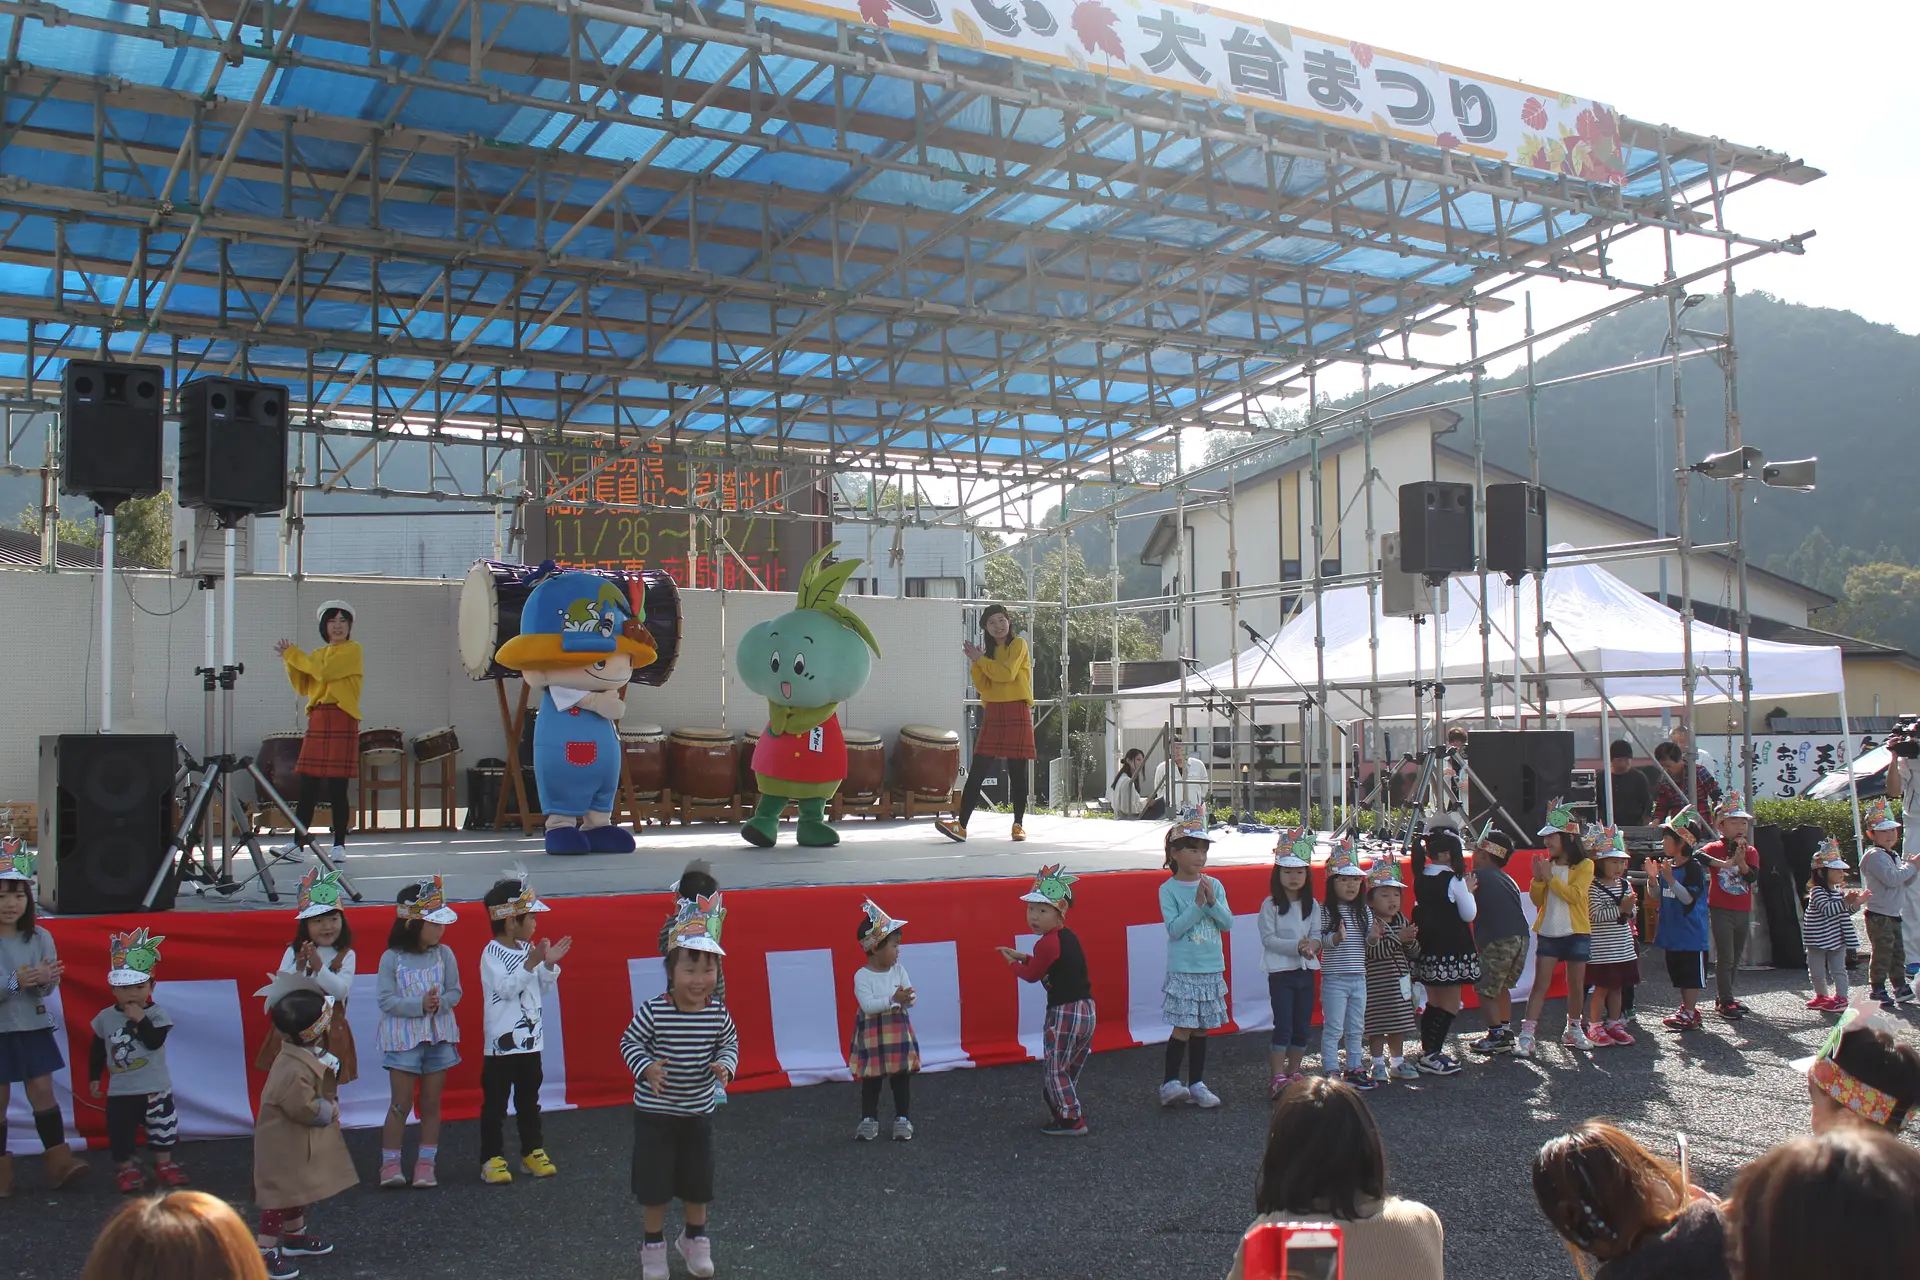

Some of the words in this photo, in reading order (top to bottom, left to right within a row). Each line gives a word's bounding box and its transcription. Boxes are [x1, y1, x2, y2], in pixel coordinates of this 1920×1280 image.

[1136, 8, 1497, 144] 大台まつり
